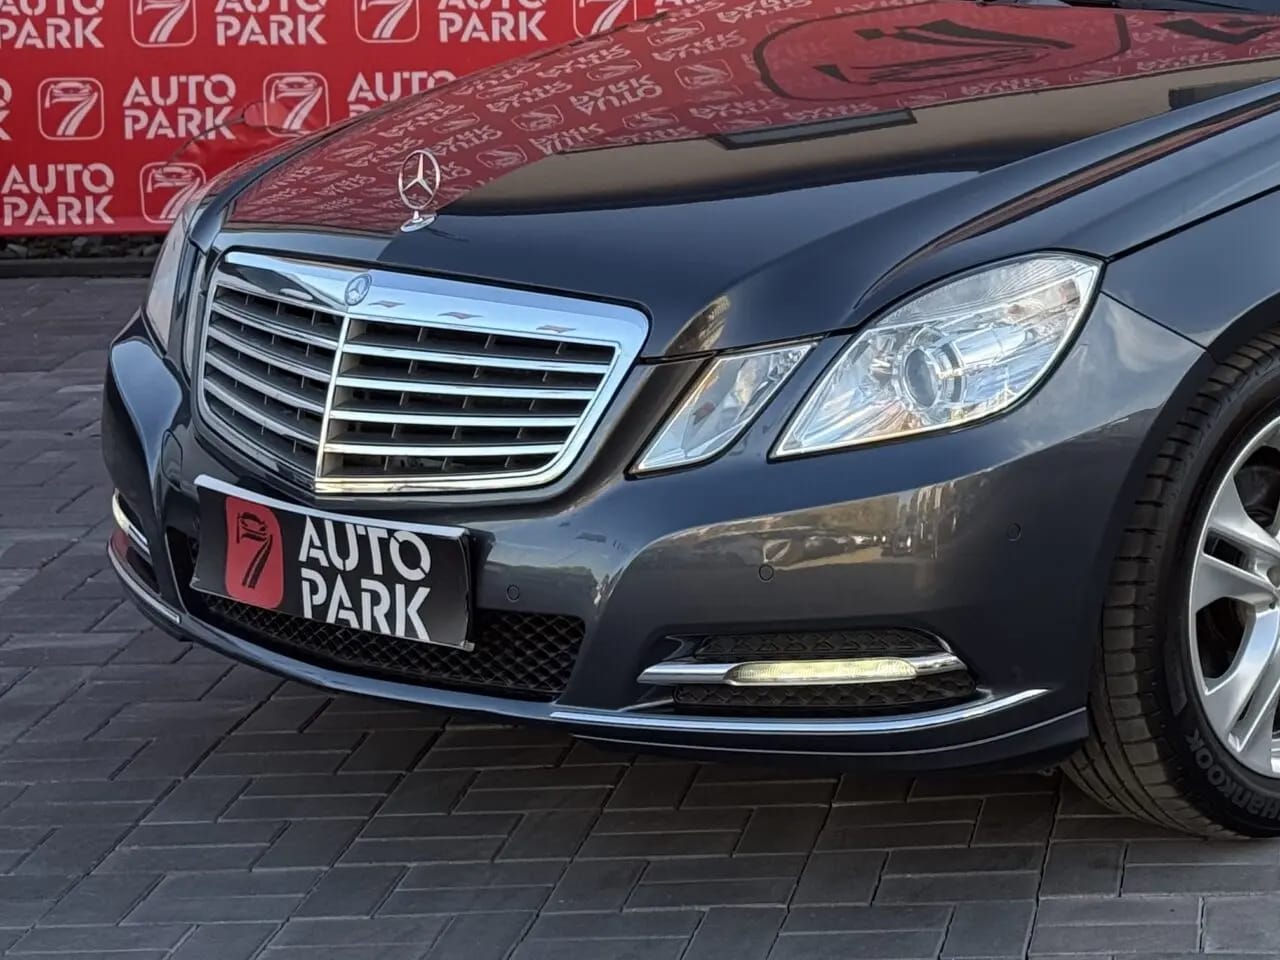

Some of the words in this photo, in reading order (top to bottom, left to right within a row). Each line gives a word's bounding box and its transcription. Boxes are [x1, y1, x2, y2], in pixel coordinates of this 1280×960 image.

[0, 17, 104, 48] PARK
[216, 14, 326, 46] PARK
[439, 11, 547, 42] PARK
[123, 74, 236, 107] AUTO
[124, 106, 236, 140] PARK
[1, 163, 114, 194] AUTO
[2, 196, 114, 227] PARK
[298, 515, 431, 581] AUTO
[301, 568, 431, 640] PARK
